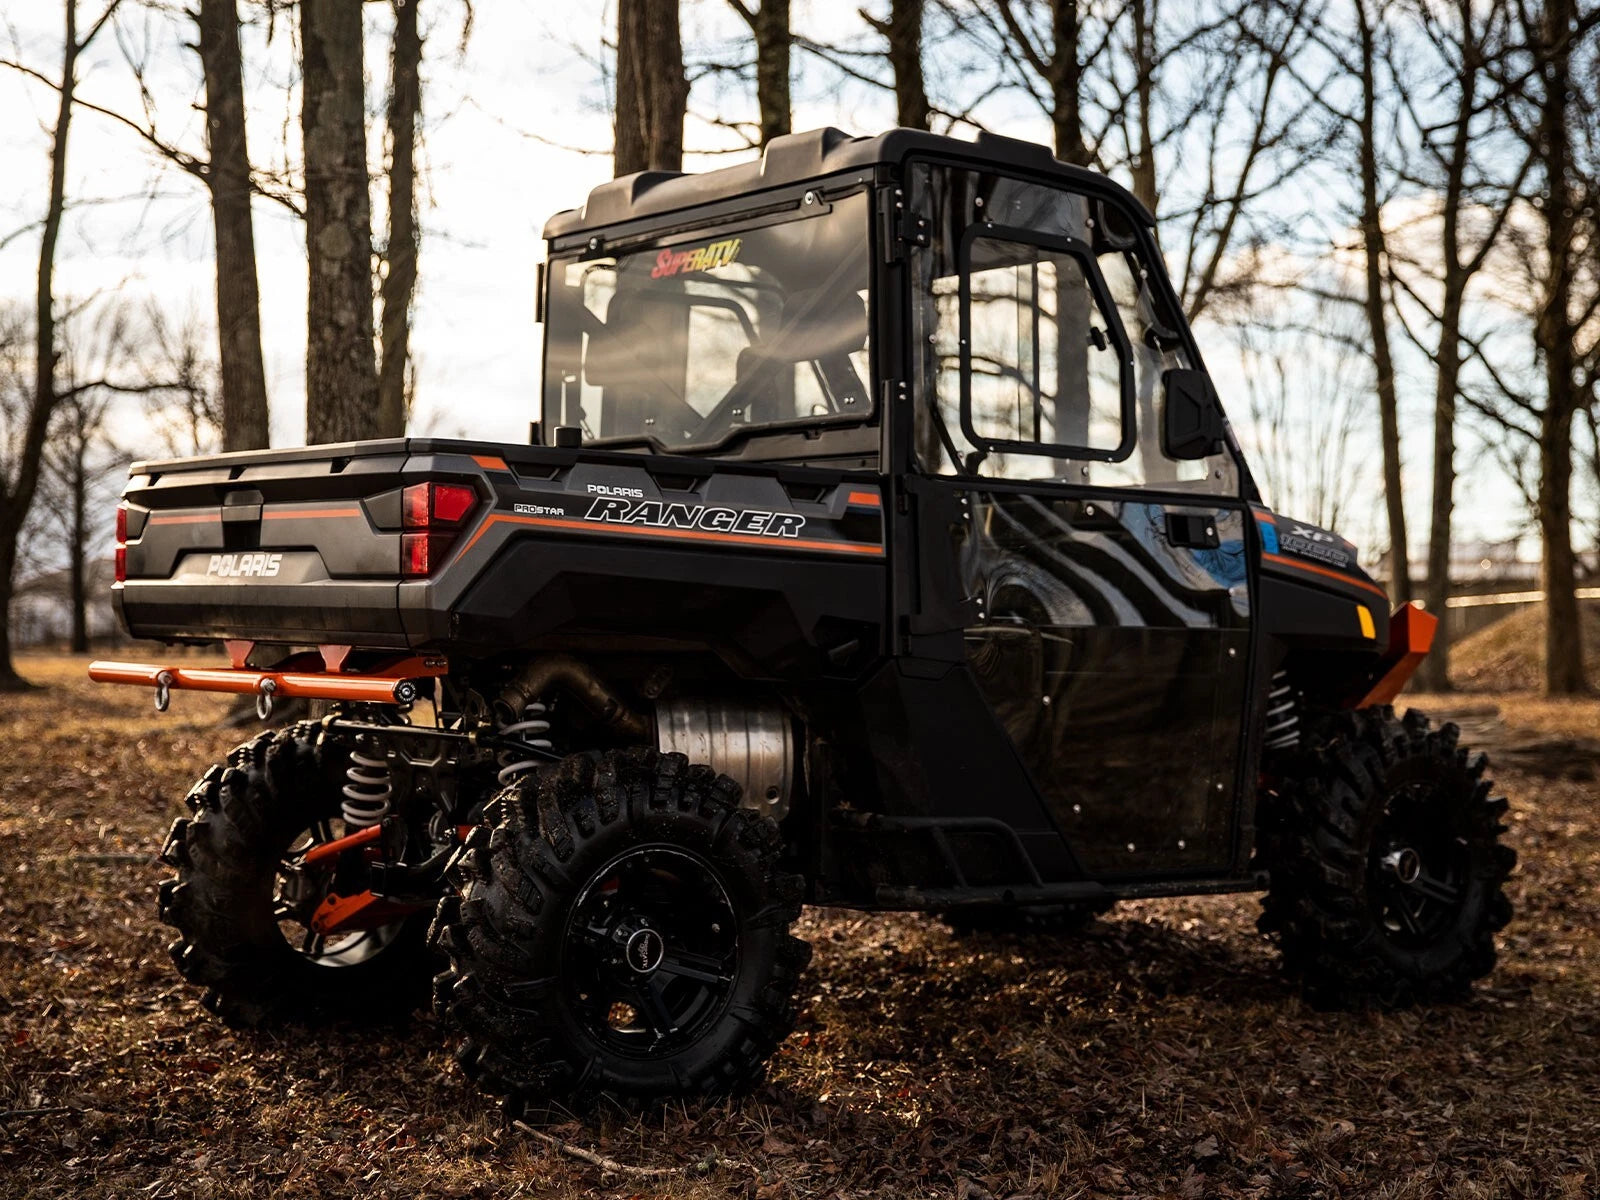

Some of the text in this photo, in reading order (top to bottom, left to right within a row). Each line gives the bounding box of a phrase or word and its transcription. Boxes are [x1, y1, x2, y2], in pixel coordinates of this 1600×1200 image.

[587, 484, 644, 498] POLARIS
[514, 503, 565, 516] PROSTAR
[583, 496, 806, 538] RANGER
[206, 553, 283, 577] POLARIS
